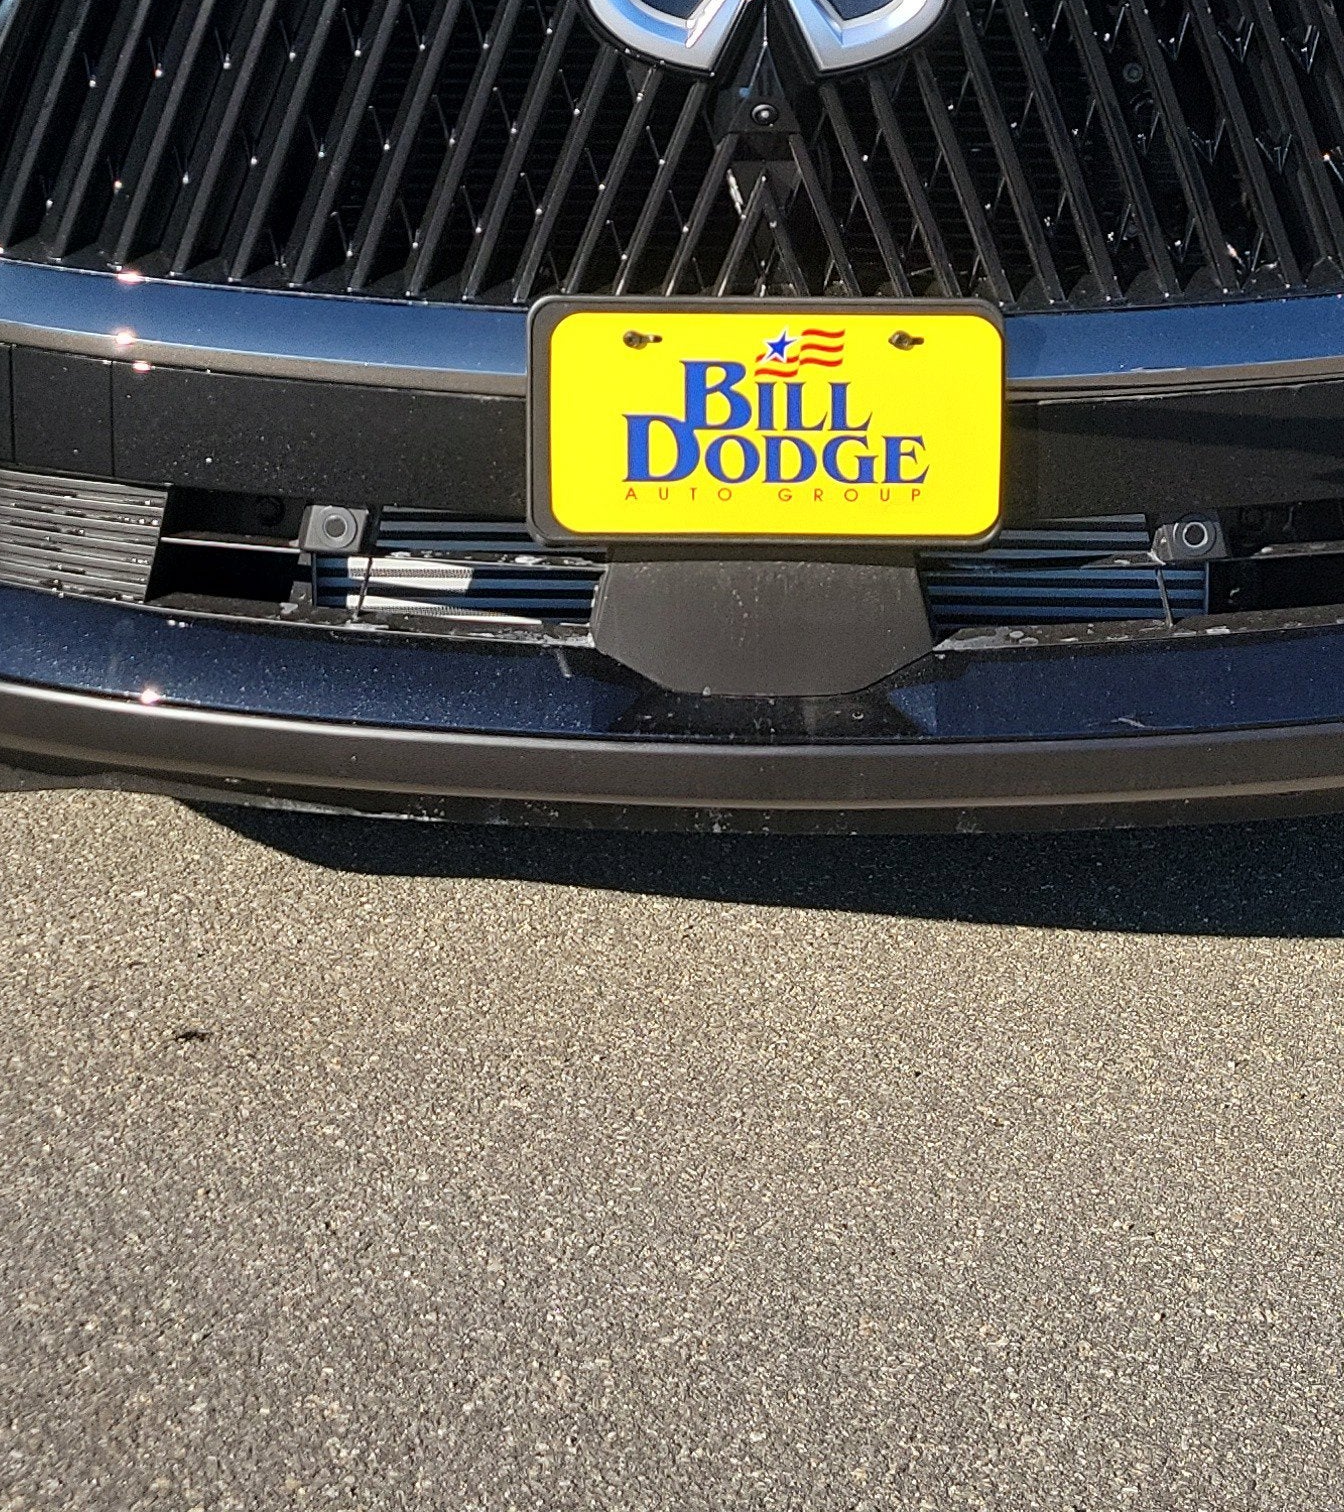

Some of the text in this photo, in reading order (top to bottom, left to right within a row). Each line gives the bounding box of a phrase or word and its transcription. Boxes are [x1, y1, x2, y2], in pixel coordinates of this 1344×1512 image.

[679, 360, 873, 432] BILL
[622, 414, 930, 484] DODGE
[625, 487, 922, 502] AUTO GROUP
